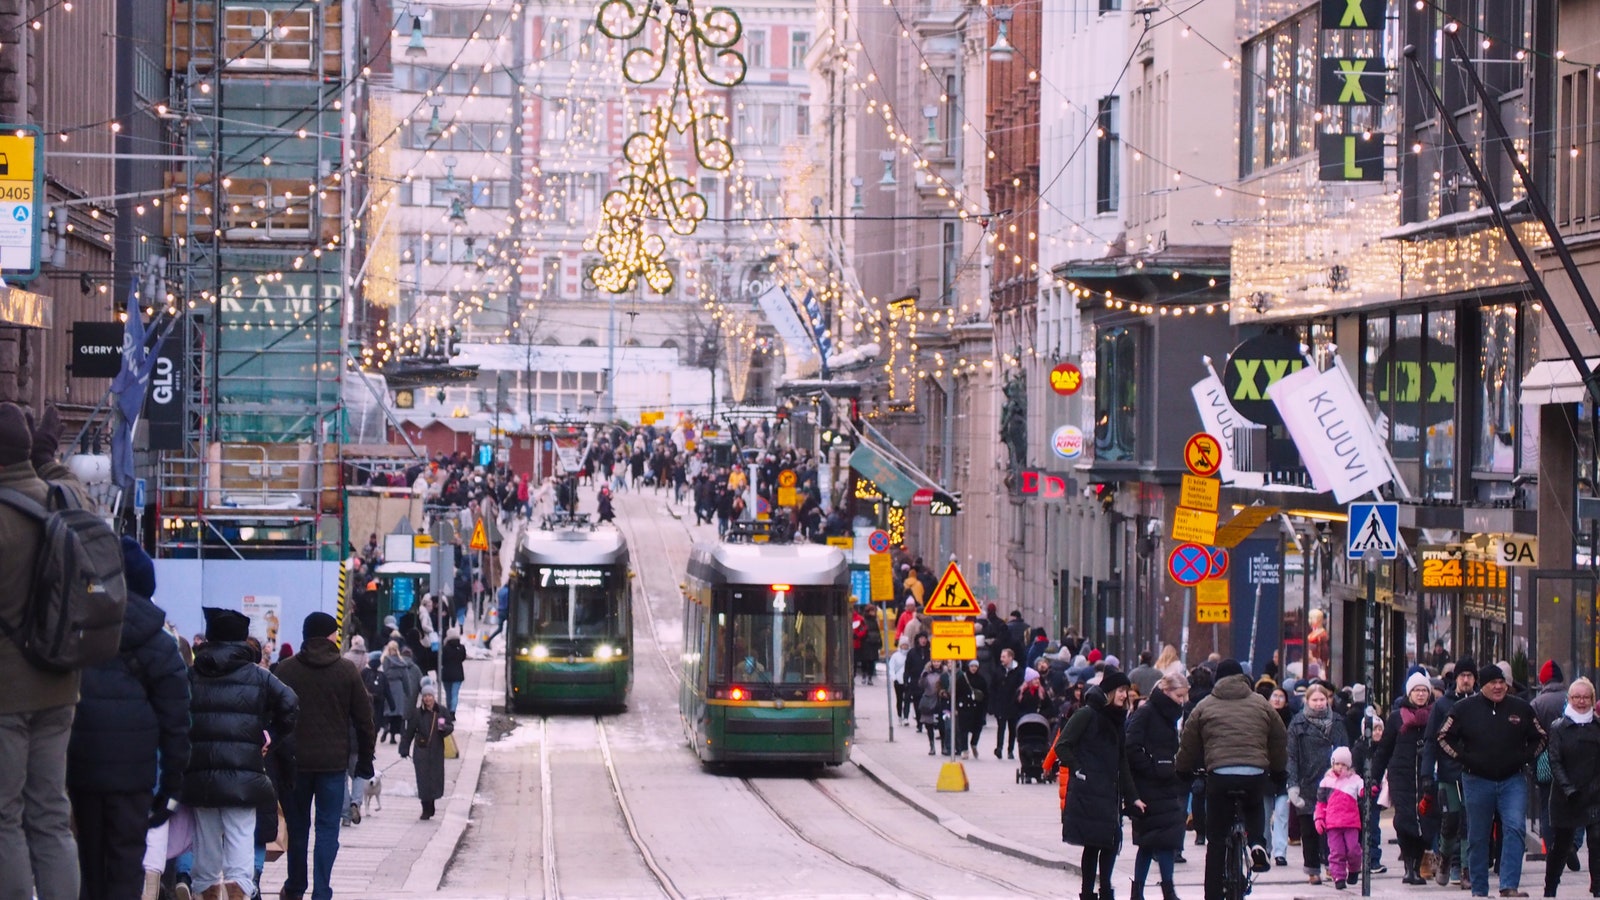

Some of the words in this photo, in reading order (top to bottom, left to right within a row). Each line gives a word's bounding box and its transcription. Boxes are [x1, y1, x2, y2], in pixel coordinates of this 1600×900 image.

[15, 207, 27, 219] A
[80, 345, 112, 354] GERRY
[152, 357, 173, 404] GLO
[1051, 371, 1080, 385] RAX
[1308, 390, 1369, 483] KLUUVI
[1503, 542, 1535, 562] 9A
[1423, 560, 1462, 576] 24
[539, 568, 552, 588] 7
[1423, 576, 1462, 587] SEVEN
[773, 591, 786, 612] 4
